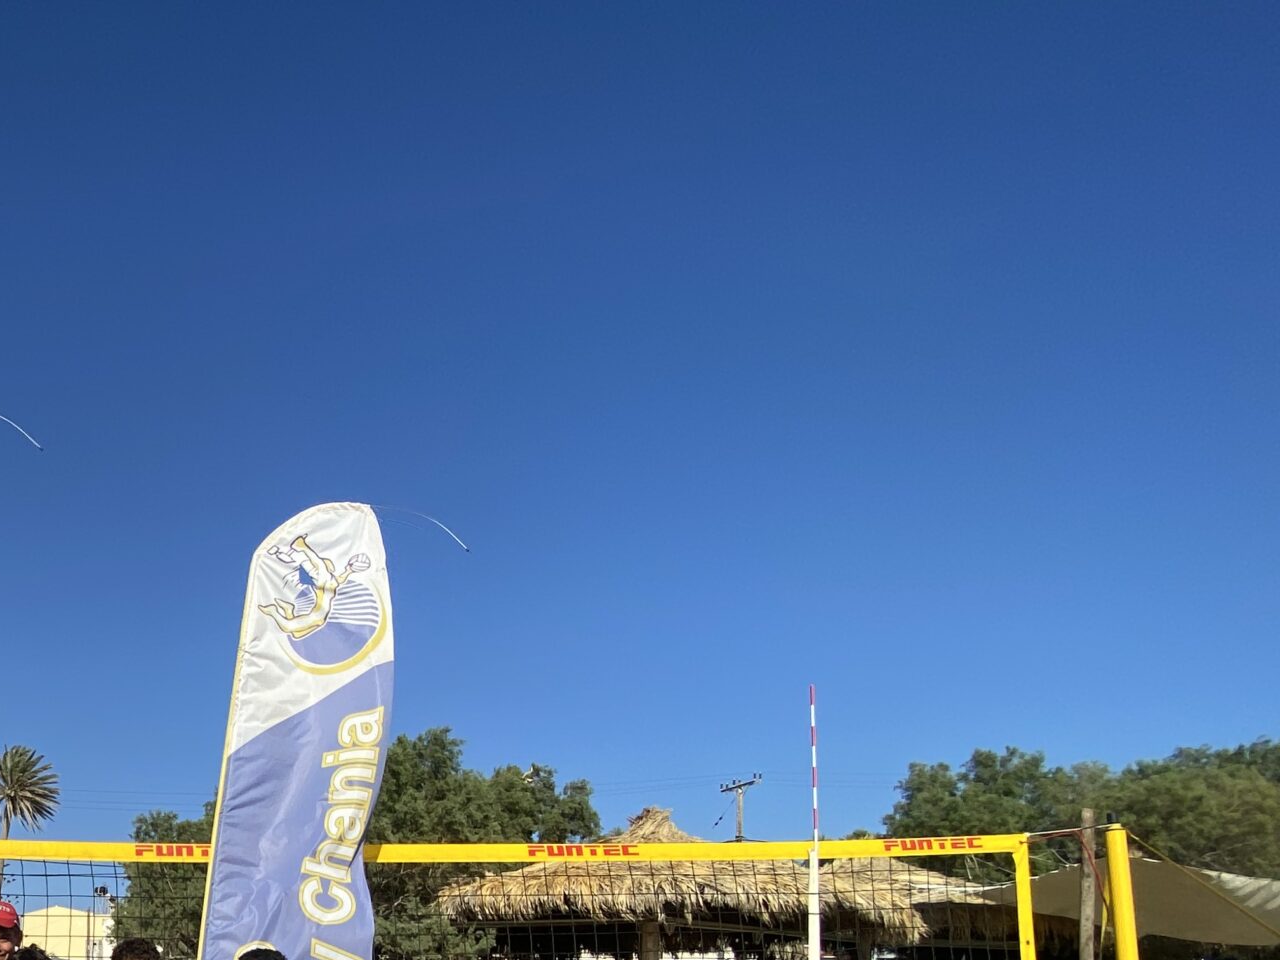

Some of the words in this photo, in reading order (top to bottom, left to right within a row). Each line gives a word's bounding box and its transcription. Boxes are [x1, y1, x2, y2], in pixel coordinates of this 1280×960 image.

[299, 706, 384, 926] Chania
[135, 845, 211, 857] FUNT
[527, 845, 640, 857] FUNTEC
[883, 837, 983, 852] FUNTEC
